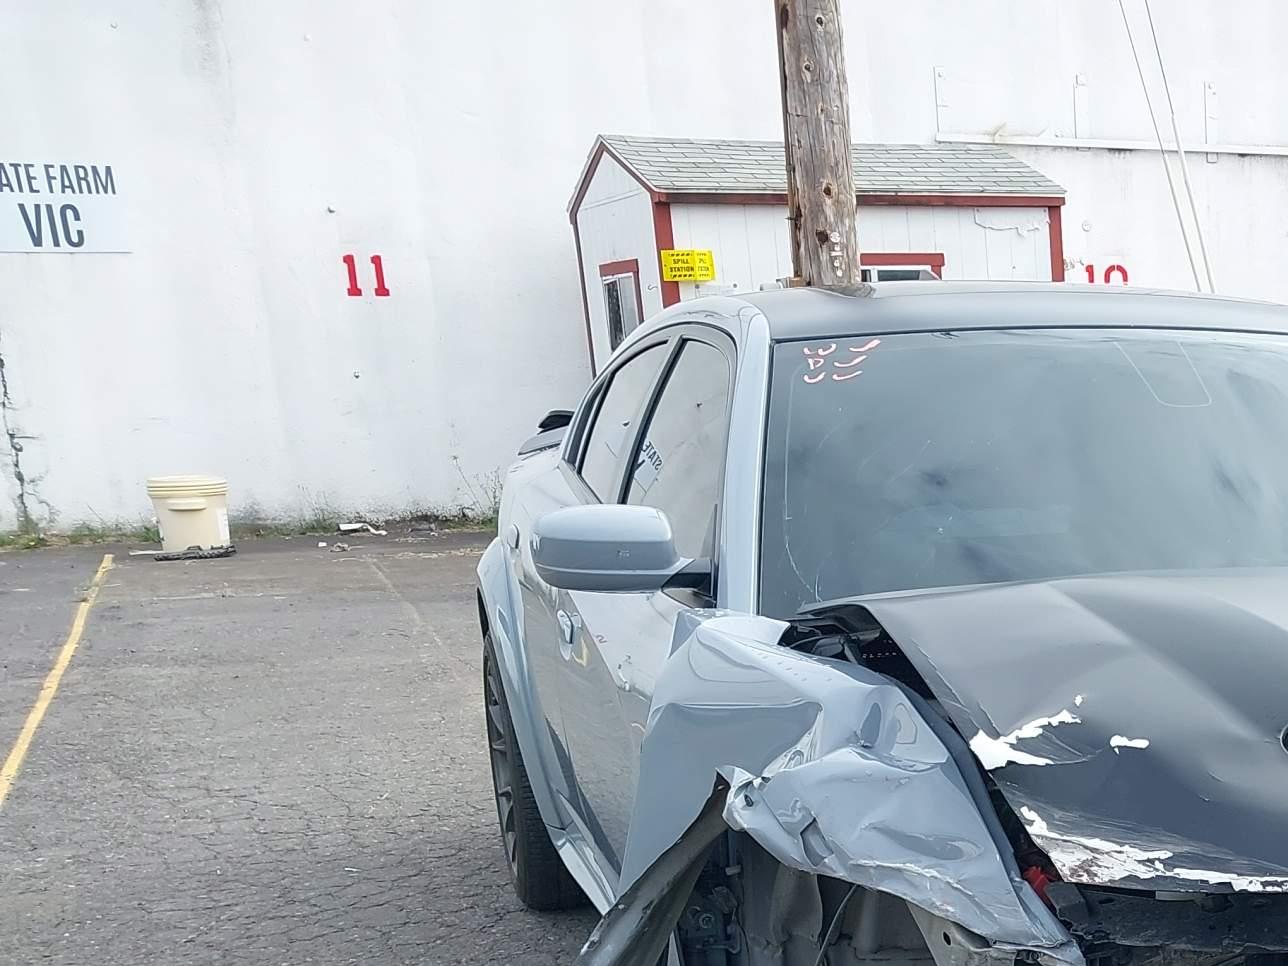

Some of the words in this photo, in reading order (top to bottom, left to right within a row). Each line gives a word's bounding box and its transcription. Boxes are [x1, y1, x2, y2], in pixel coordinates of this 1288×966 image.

[43, 164, 117, 195] FARM
[17, 203, 85, 248] VIC
[342, 253, 391, 297] 11
